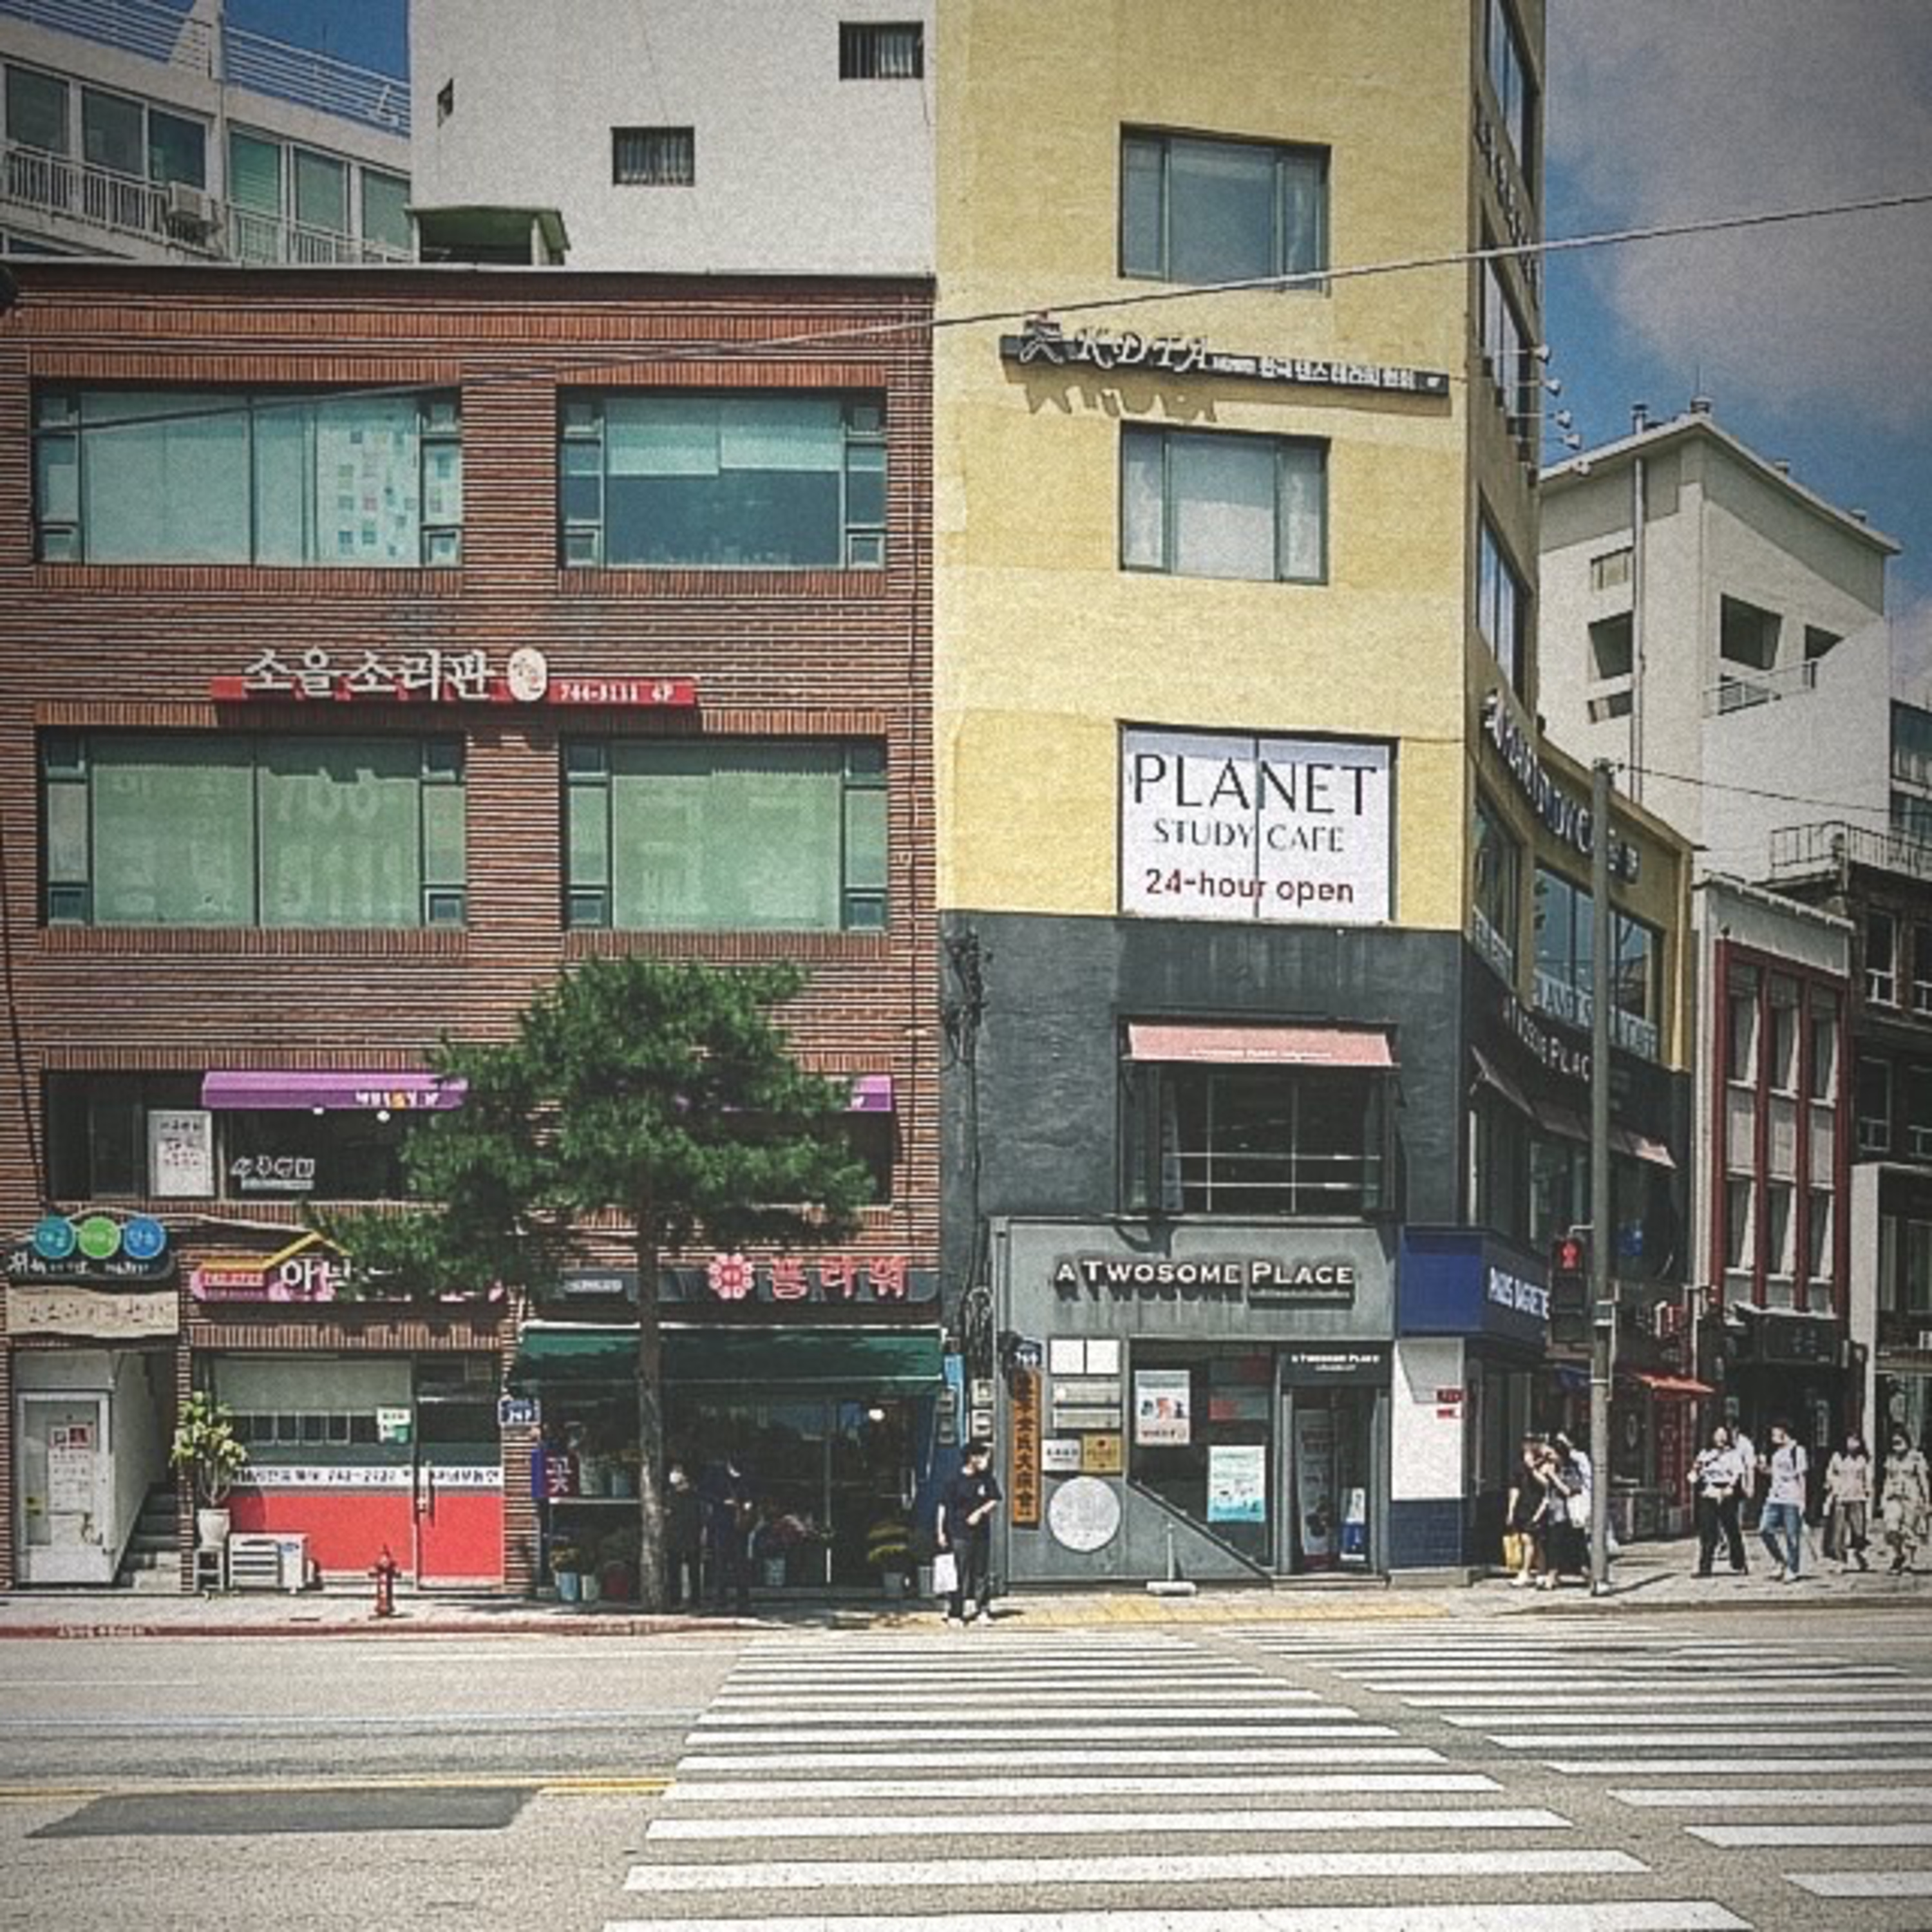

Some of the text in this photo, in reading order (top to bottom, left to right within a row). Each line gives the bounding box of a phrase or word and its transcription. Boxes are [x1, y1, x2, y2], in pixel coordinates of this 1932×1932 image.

[1072, 328, 1207, 372] KDTA
[243, 646, 497, 701] 소울소리판
[1134, 753, 1378, 816] PLANET
[1153, 818, 1345, 853] STUDY CAFE
[1145, 868, 1354, 909] 24-hour open
[1083, 1260, 1241, 1283] TWOSOME
[1251, 1261, 1353, 1284] PLACE
[546, 1456, 572, 1493] 꽃
